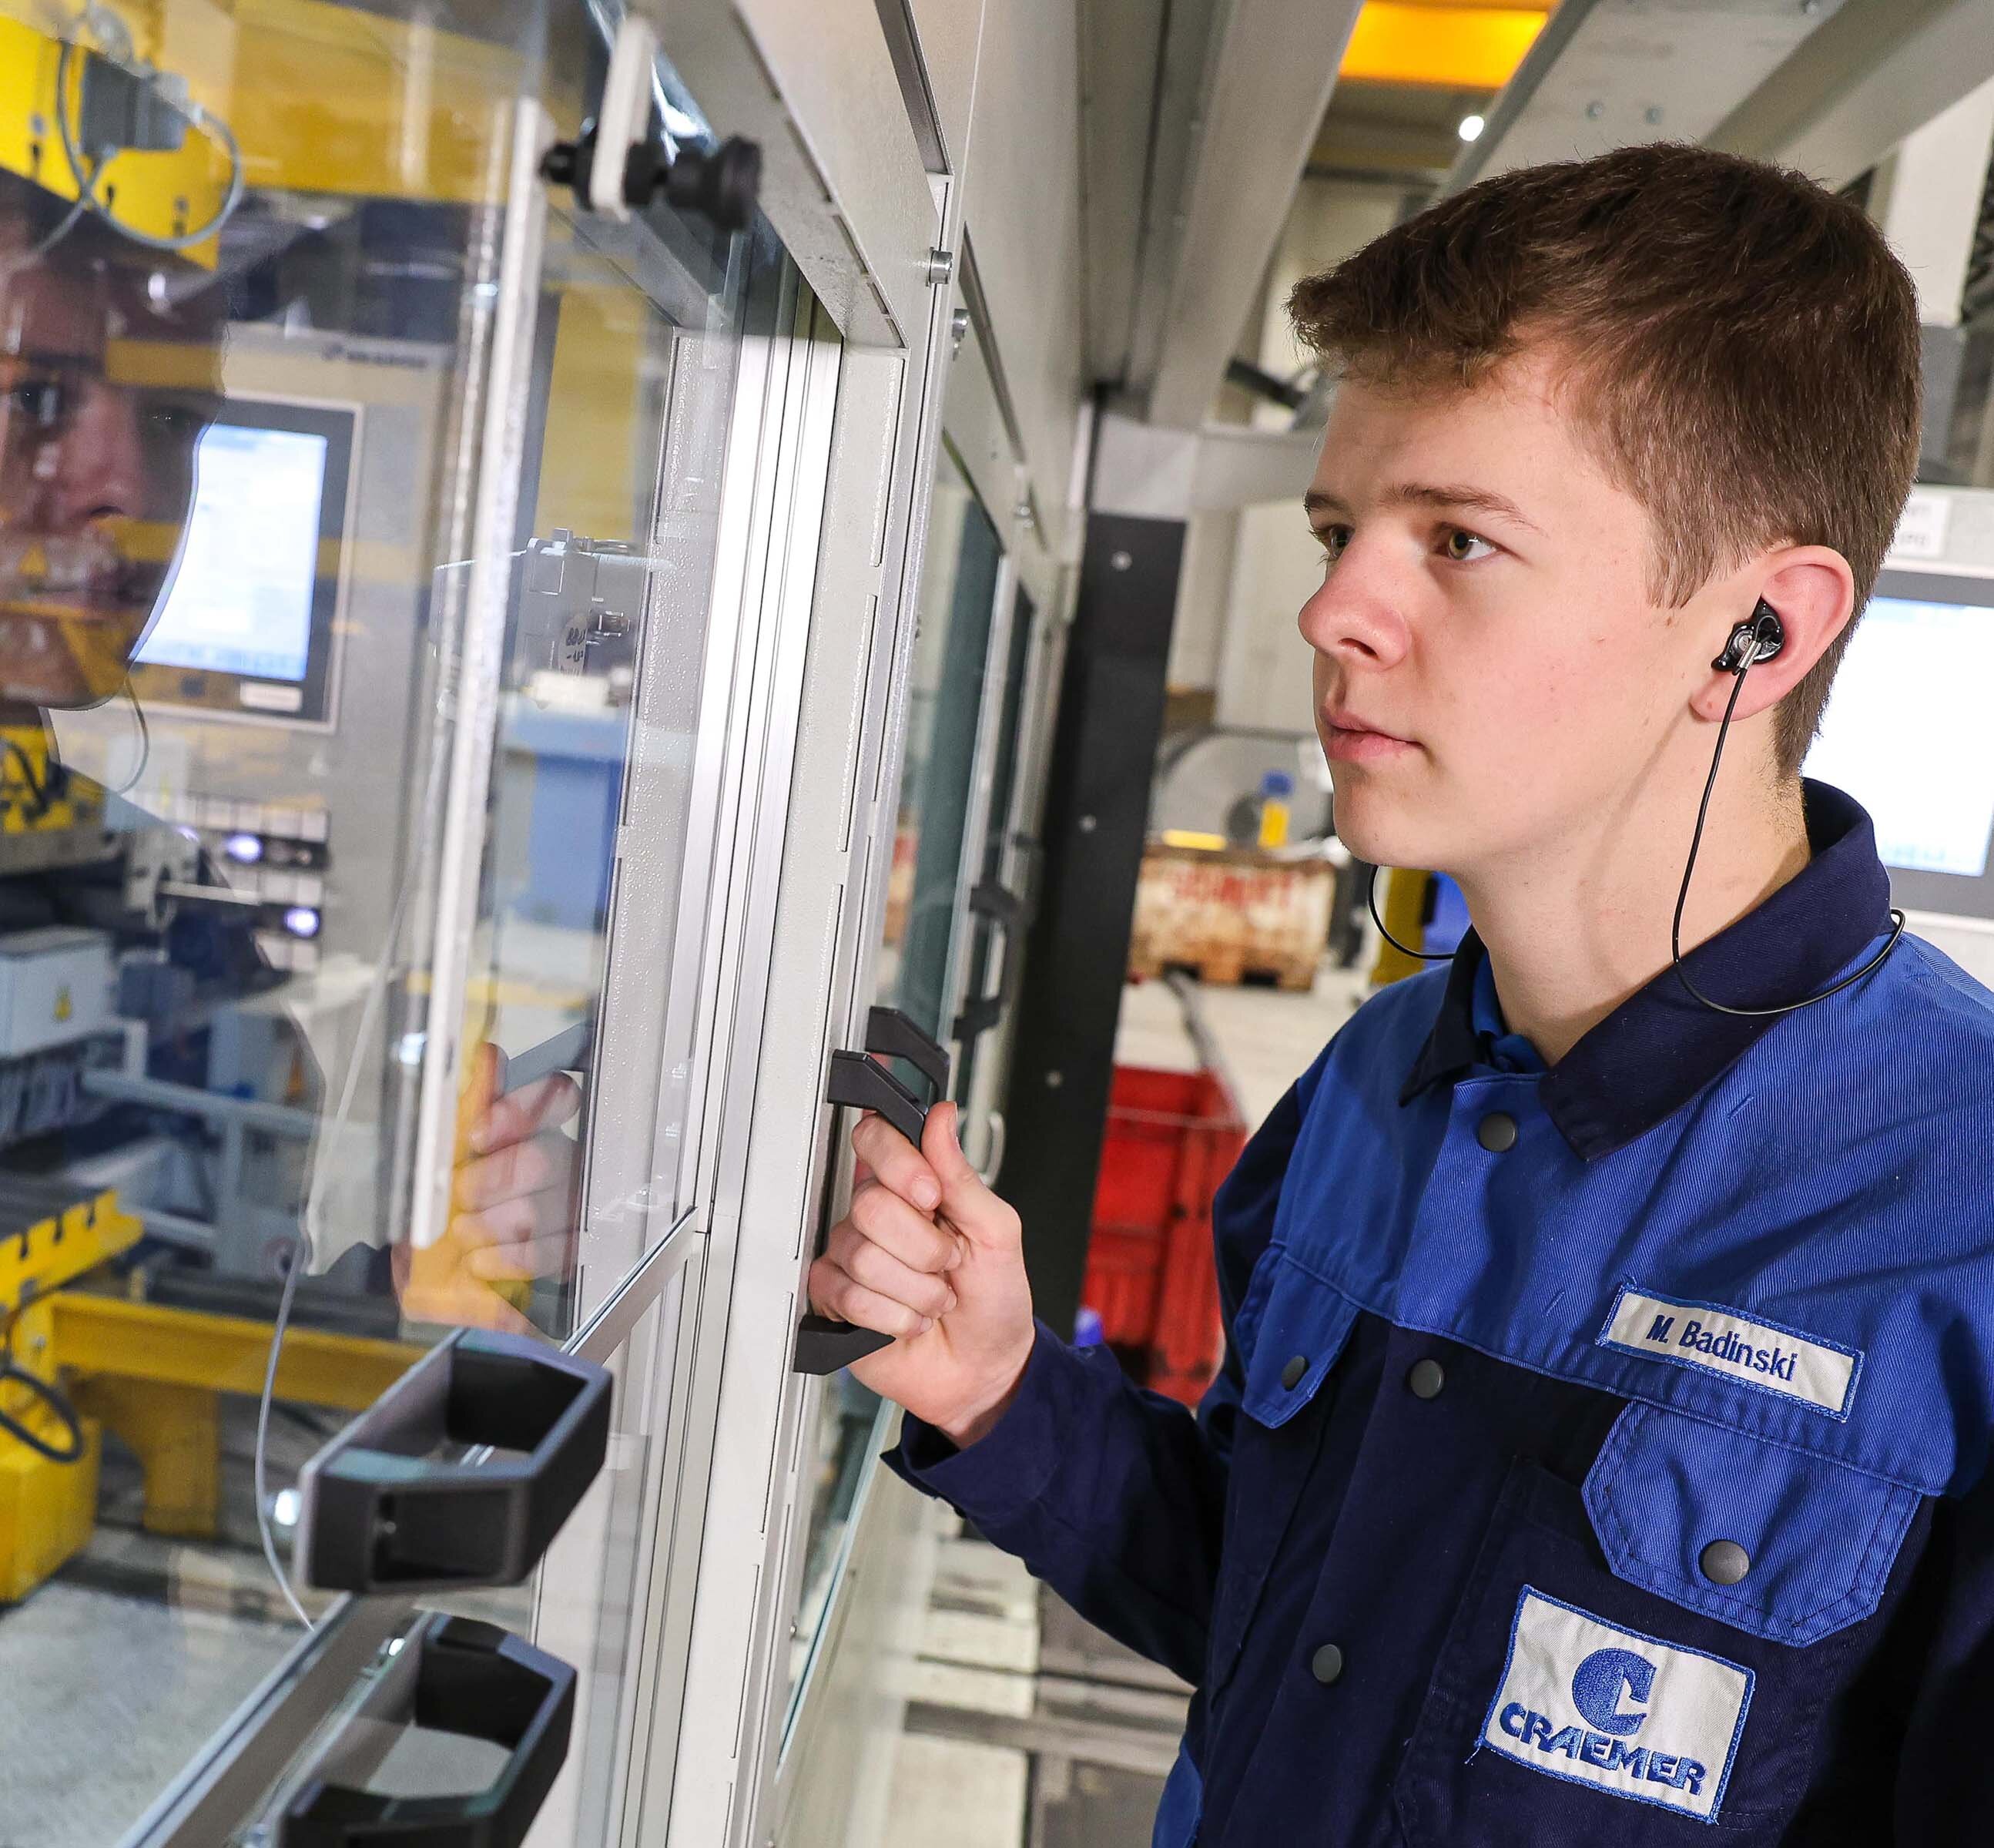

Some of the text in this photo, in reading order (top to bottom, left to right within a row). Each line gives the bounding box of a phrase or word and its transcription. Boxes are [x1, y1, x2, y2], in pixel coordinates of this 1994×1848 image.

[1646, 1314, 1798, 1381] M. Badinski
[1499, 1702, 1707, 1796] CRAEMER
